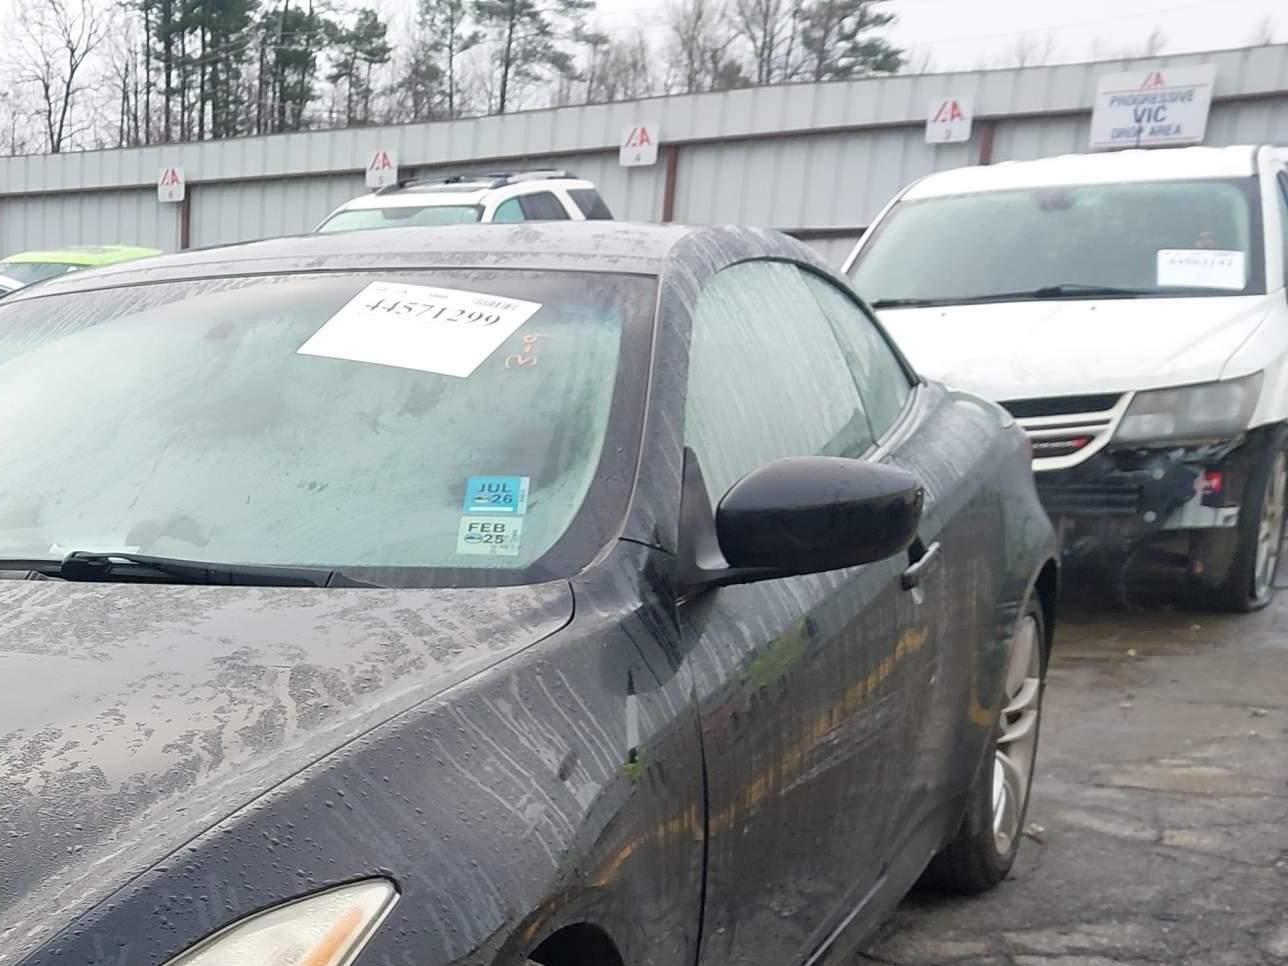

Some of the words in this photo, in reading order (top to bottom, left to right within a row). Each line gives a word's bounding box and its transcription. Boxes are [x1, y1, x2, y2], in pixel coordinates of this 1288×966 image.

[1109, 89, 1196, 106] PROGRESSIVE
[1133, 105, 1167, 123] VIC
[1111, 126, 1143, 139] DROP
[1148, 124, 1181, 136] AREA
[365, 298, 502, 327] 44571299
[476, 483, 513, 493] JUL
[491, 494, 513, 504] 26
[468, 522, 506, 533] FEB
[483, 534, 505, 544] 25
